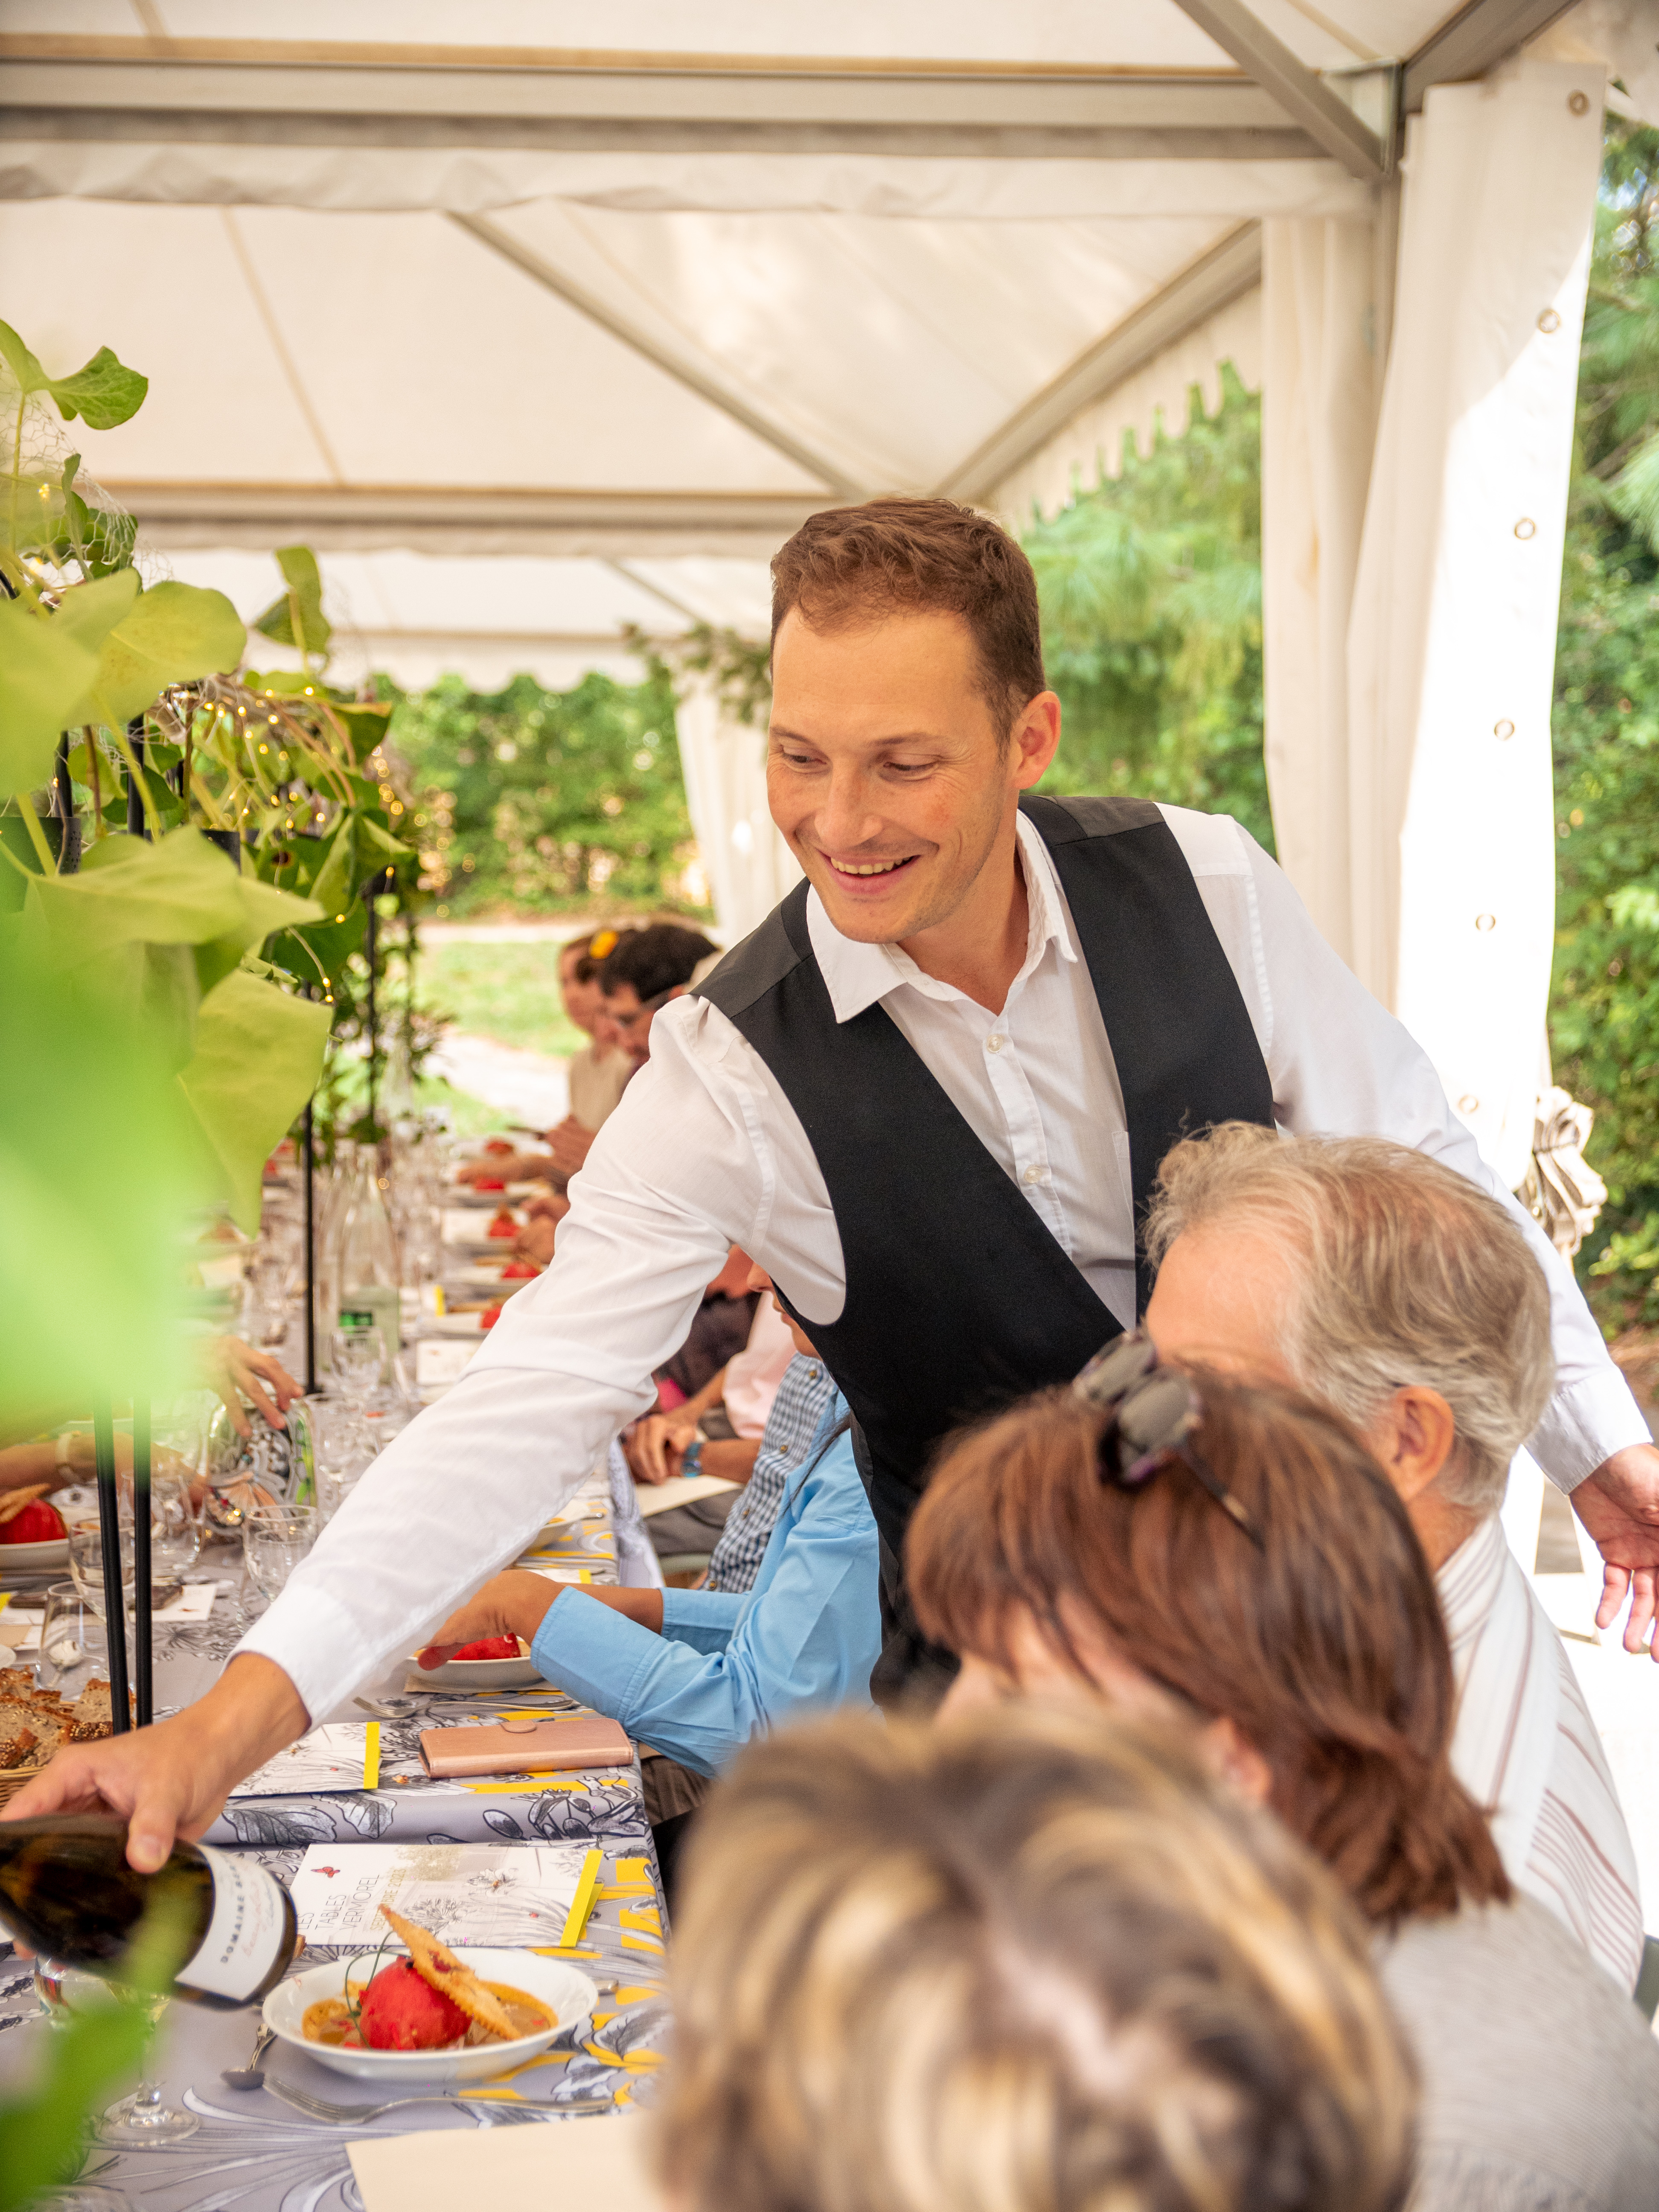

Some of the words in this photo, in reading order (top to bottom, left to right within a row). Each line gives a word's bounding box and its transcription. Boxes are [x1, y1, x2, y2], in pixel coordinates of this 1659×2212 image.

[297, 1912, 315, 1930] LES
[315, 1895, 346, 1930] TABLES
[339, 1874, 379, 1930] VERMOREL
[370, 1890, 398, 1931] SEPTBRE
[388, 1869, 407, 1887] 2023
[220, 1895, 245, 1964] DOMAINE
